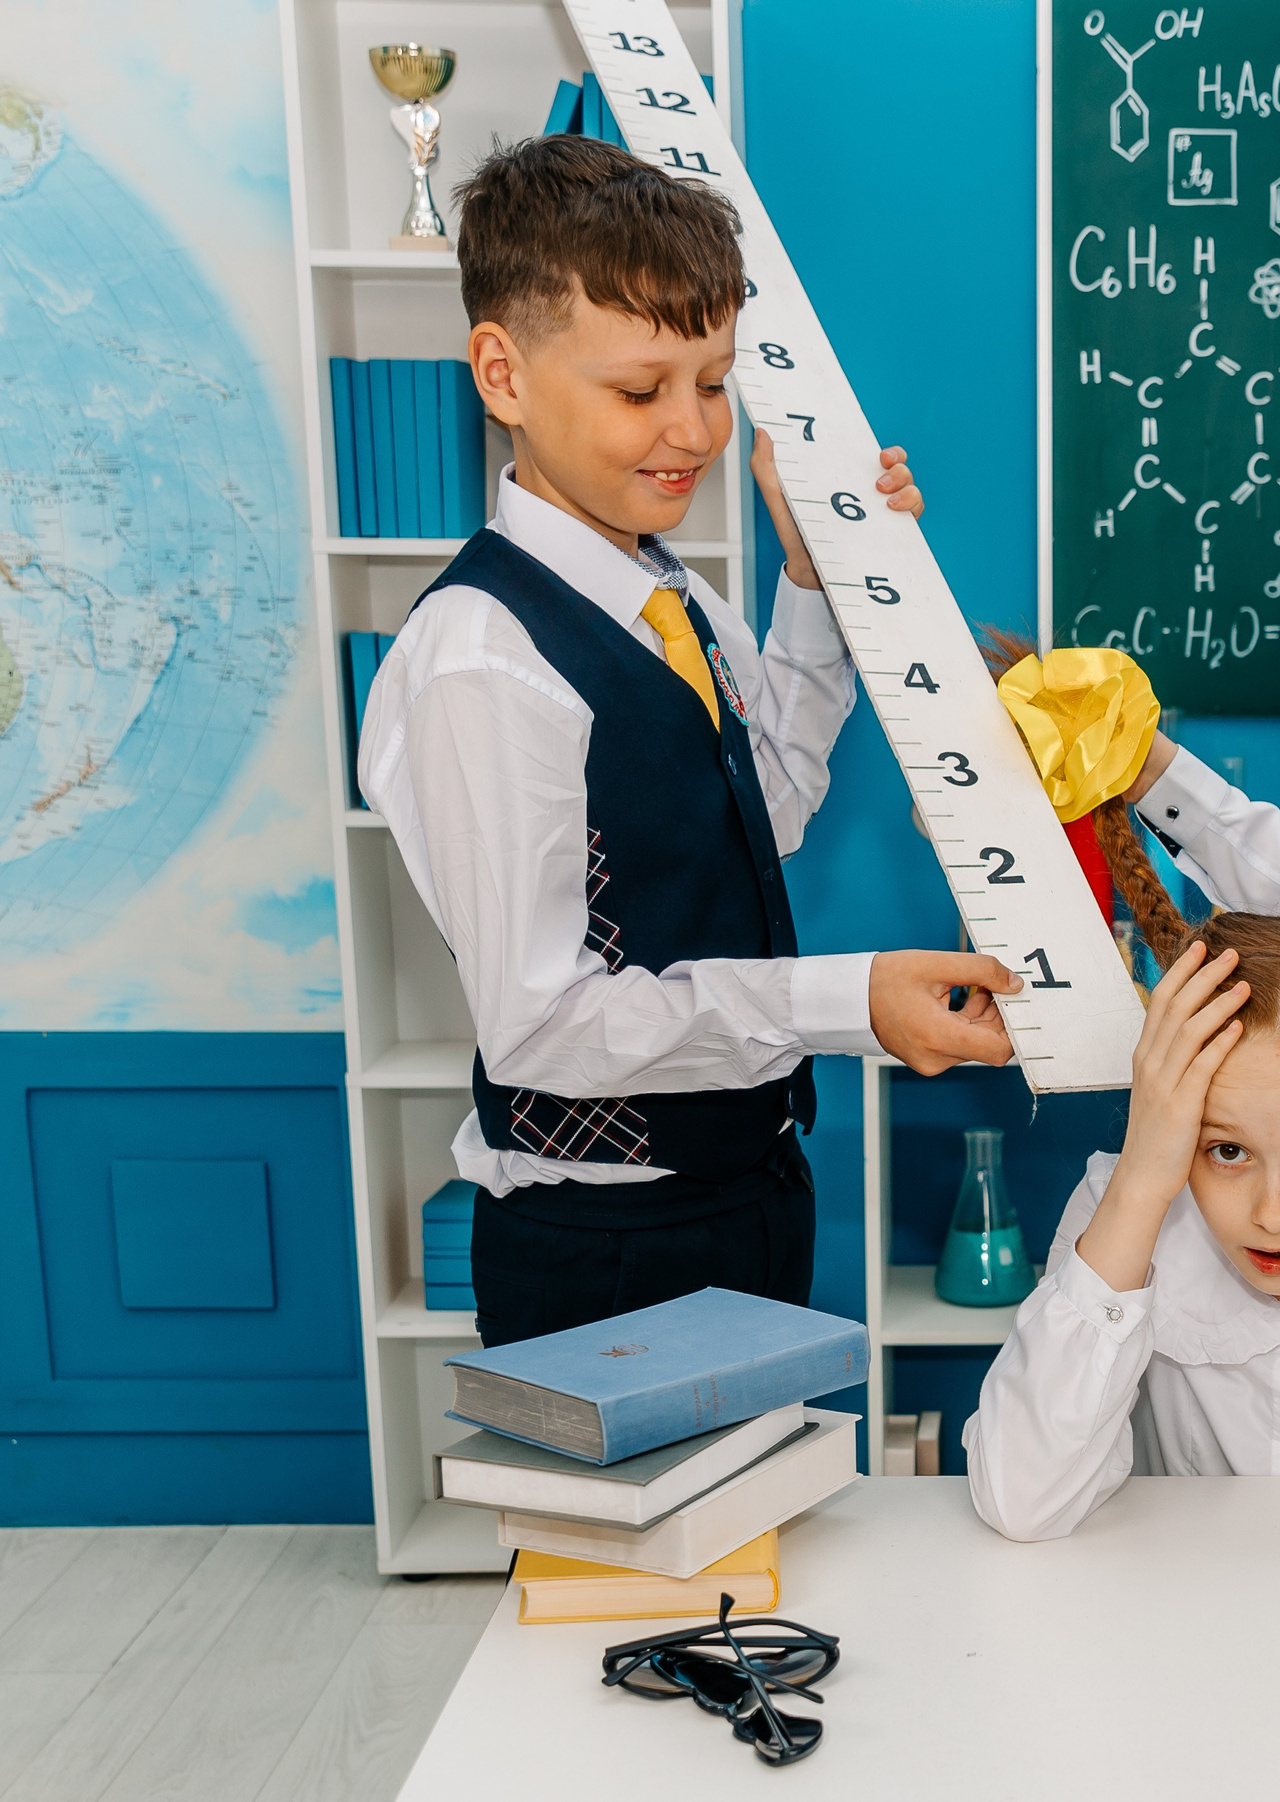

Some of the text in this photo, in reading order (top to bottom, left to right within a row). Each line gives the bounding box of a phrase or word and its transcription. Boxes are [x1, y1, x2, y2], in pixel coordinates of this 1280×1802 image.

[1154, 7, 1203, 41] OH
[608, 31, 666, 57] 13
[635, 87, 697, 116] 12
[660, 146, 722, 177] 11
[1069, 225, 1177, 299] C6H6
[1194, 236, 1215, 275] H
[758, 342, 795, 370] 8
[1189, 322, 1216, 357] C
[1080, 349, 1102, 384] H
[1137, 376, 1163, 409] C
[1245, 371, 1274, 405] C
[786, 412, 816, 443] 7
[1133, 454, 1161, 489] C
[1247, 452, 1271, 484] C
[830, 491, 867, 522] 6
[1094, 509, 1115, 537] H
[1195, 500, 1220, 534] C
[864, 575, 901, 606] 5
[1194, 564, 1215, 592] H
[904, 662, 941, 694] 4
[936, 751, 978, 787] 3
[979, 846, 1026, 885] 2
[1024, 948, 1072, 989] 1
